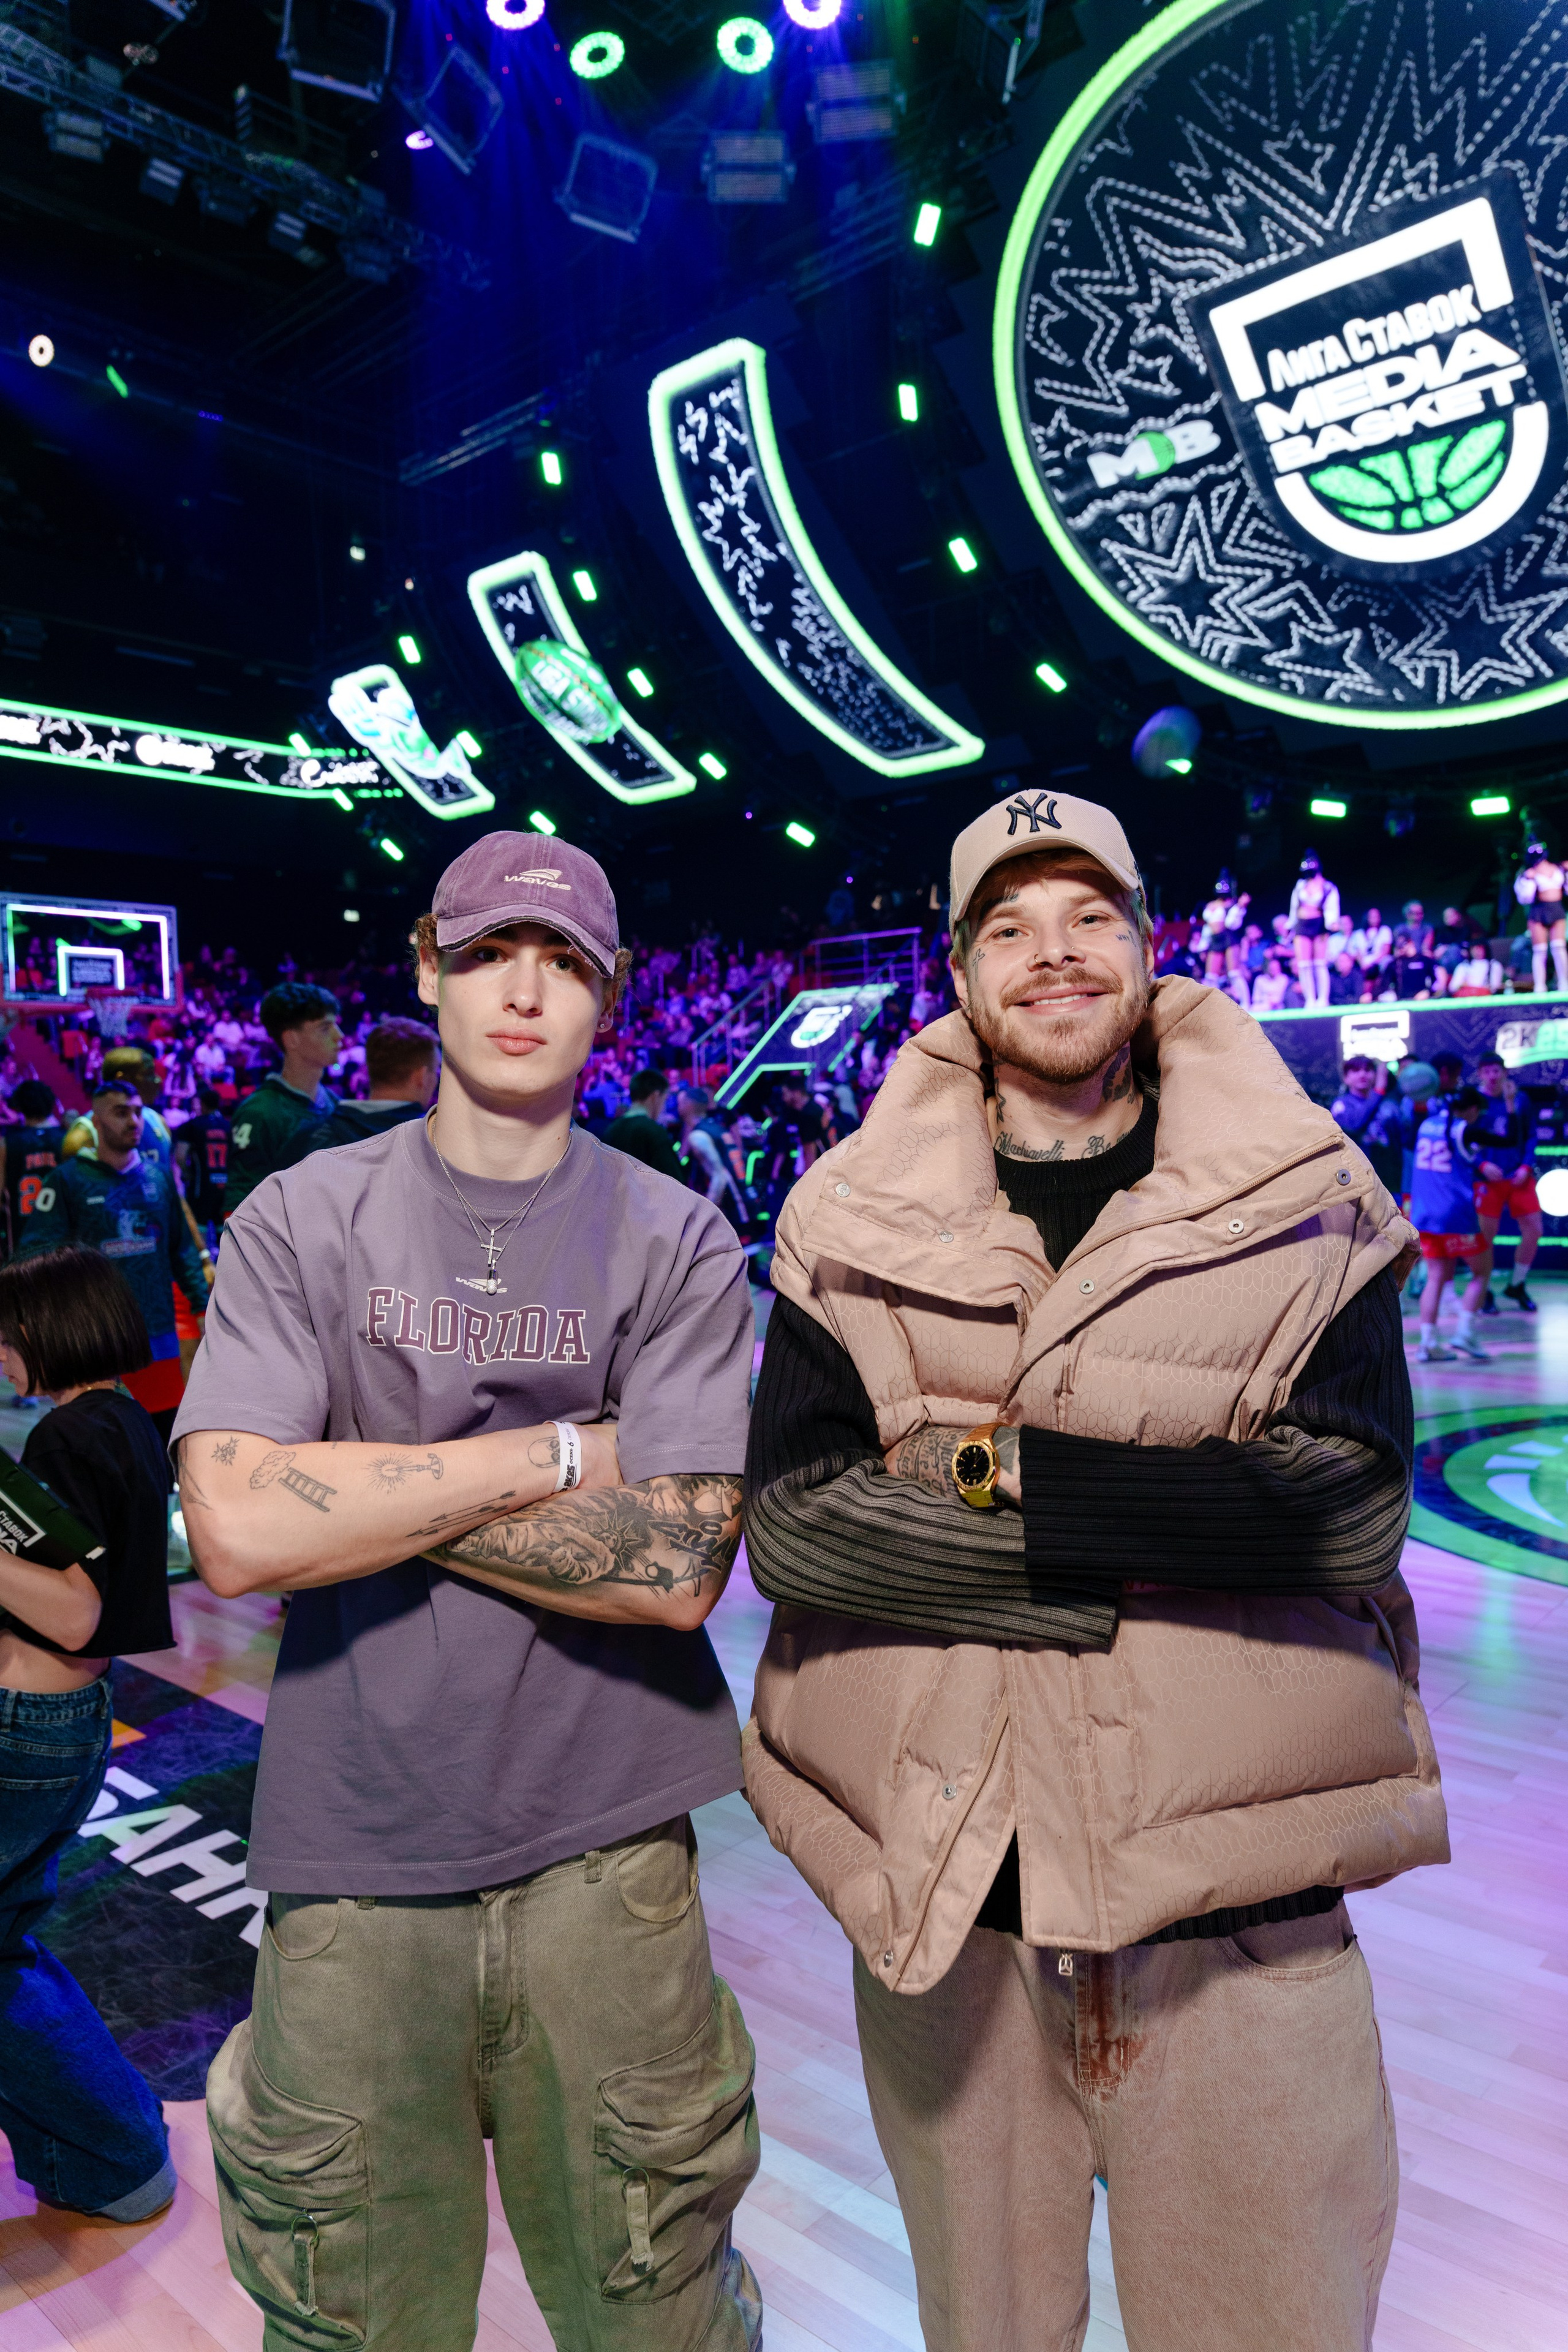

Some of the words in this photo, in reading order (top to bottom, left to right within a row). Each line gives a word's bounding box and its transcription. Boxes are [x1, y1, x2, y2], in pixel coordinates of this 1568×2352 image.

[1254, 328, 1521, 443] MEDIA
[1270, 364, 1527, 473] BASKET
[1006, 792, 1062, 835] NY
[1415, 1137, 1452, 1174] 22
[366, 1287, 590, 1366] FLORIDA
